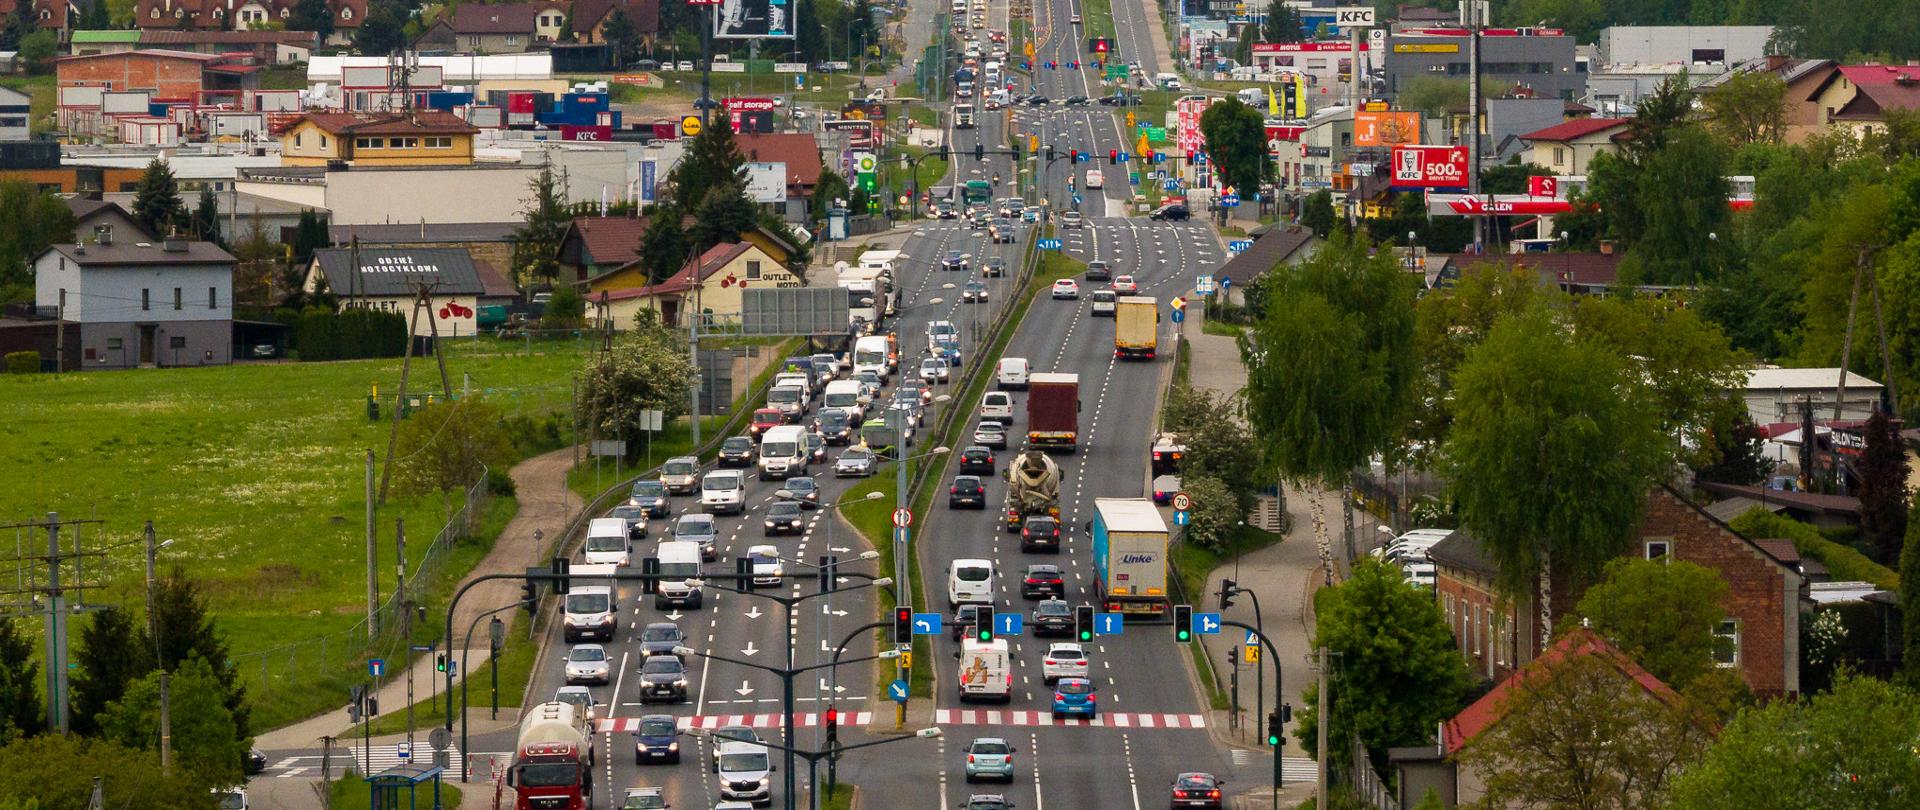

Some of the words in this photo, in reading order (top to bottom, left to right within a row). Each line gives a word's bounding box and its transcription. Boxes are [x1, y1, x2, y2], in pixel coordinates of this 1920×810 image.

[1340, 11, 1372, 22] KFC
[744, 102, 773, 110] storage
[576, 131, 598, 140] KFC
[378, 256, 414, 265] ODZIEŻ
[360, 265, 438, 273] MOTOCYKLOWA
[763, 273, 792, 281] OUTLET
[346, 300, 398, 311] OUTLET
[1831, 431, 1851, 446] SALON
[1176, 498, 1188, 507] 70
[1123, 554, 1152, 563] Linke
